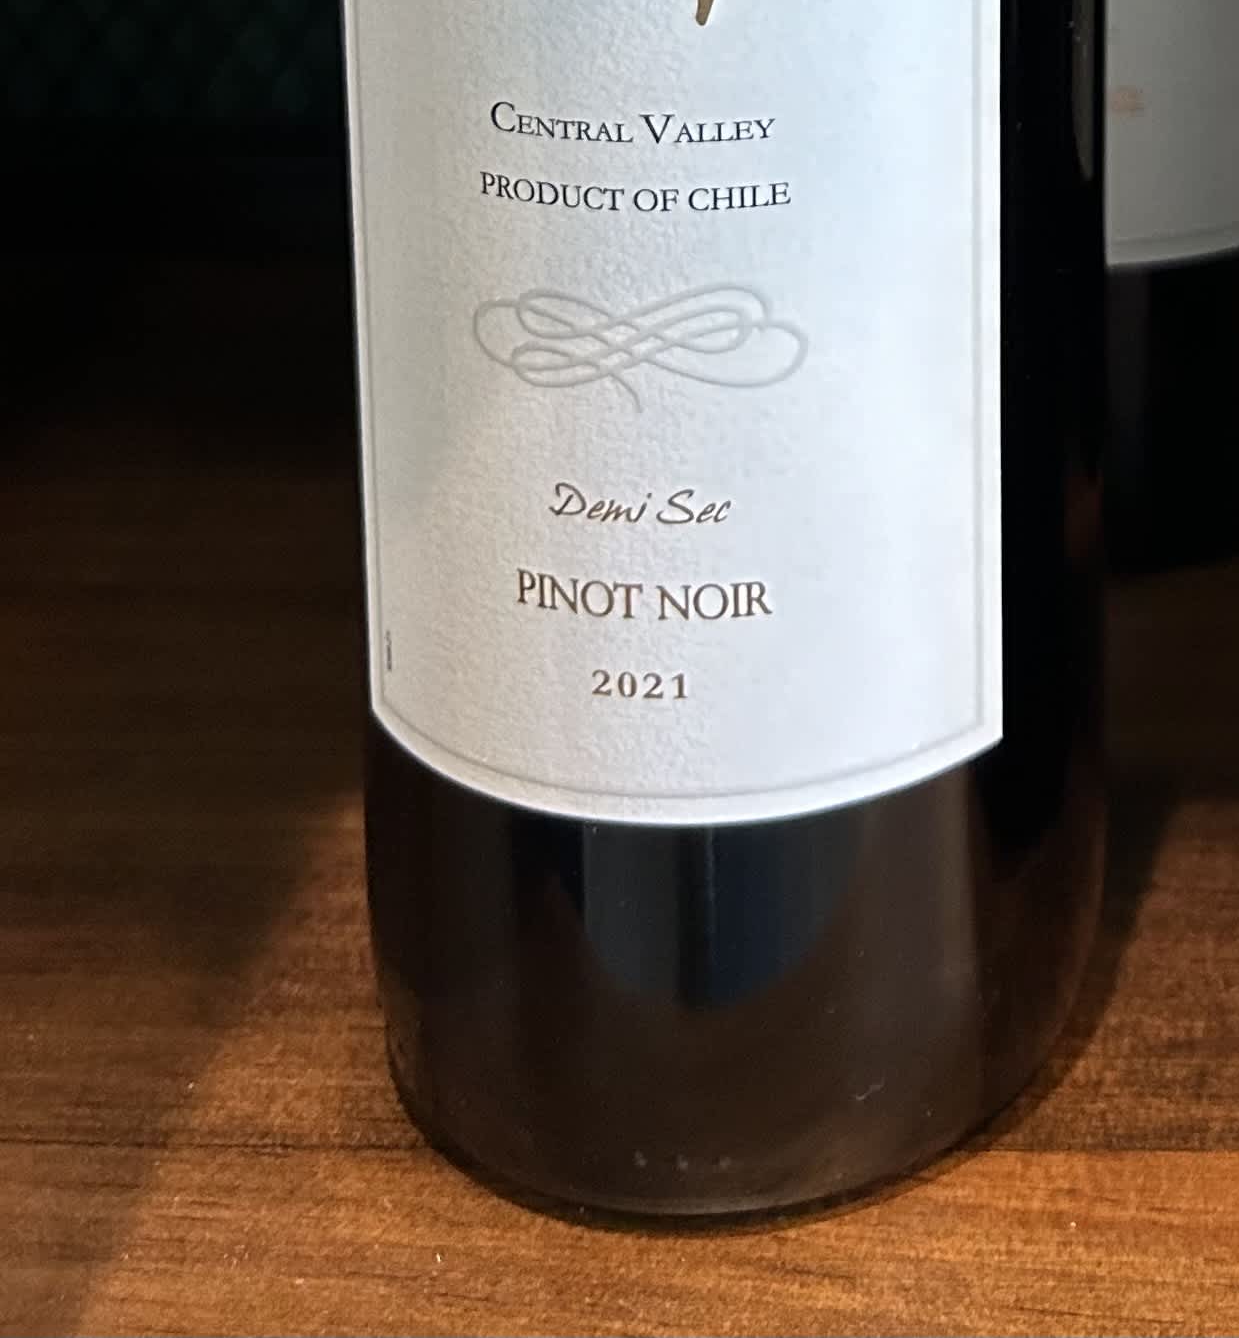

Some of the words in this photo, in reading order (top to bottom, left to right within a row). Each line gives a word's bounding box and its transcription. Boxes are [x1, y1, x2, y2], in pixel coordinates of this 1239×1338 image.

[490, 101, 633, 145] CENTRAL
[639, 113, 776, 145] VALLEY
[480, 172, 624, 213] PRODUCT
[633, 188, 679, 213] OF
[688, 182, 791, 212] CHILE
[549, 482, 652, 525] Demi
[656, 489, 733, 525] Sec
[516, 568, 643, 619] PINOT
[658, 581, 773, 621] NOIR
[591, 669, 688, 700] 2021
